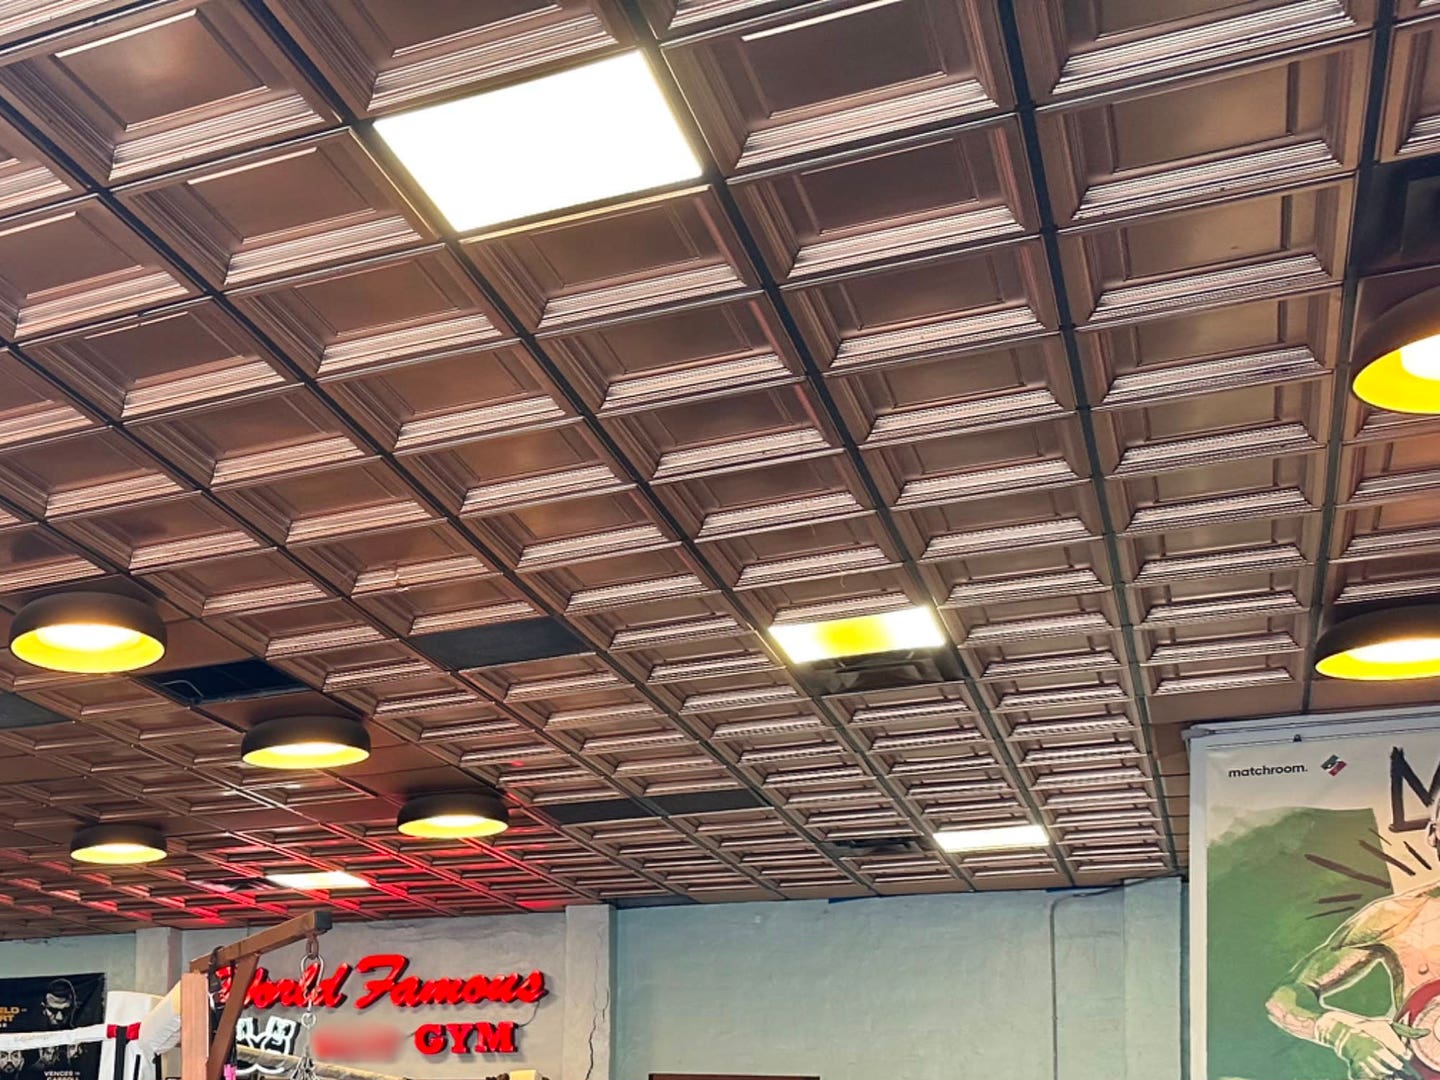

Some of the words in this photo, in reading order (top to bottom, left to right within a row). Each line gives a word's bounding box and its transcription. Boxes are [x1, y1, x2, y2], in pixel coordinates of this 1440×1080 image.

[1228, 763, 1309, 778] matchroom.
[354, 953, 545, 1009] Famous
[414, 1021, 514, 1055] GYM
